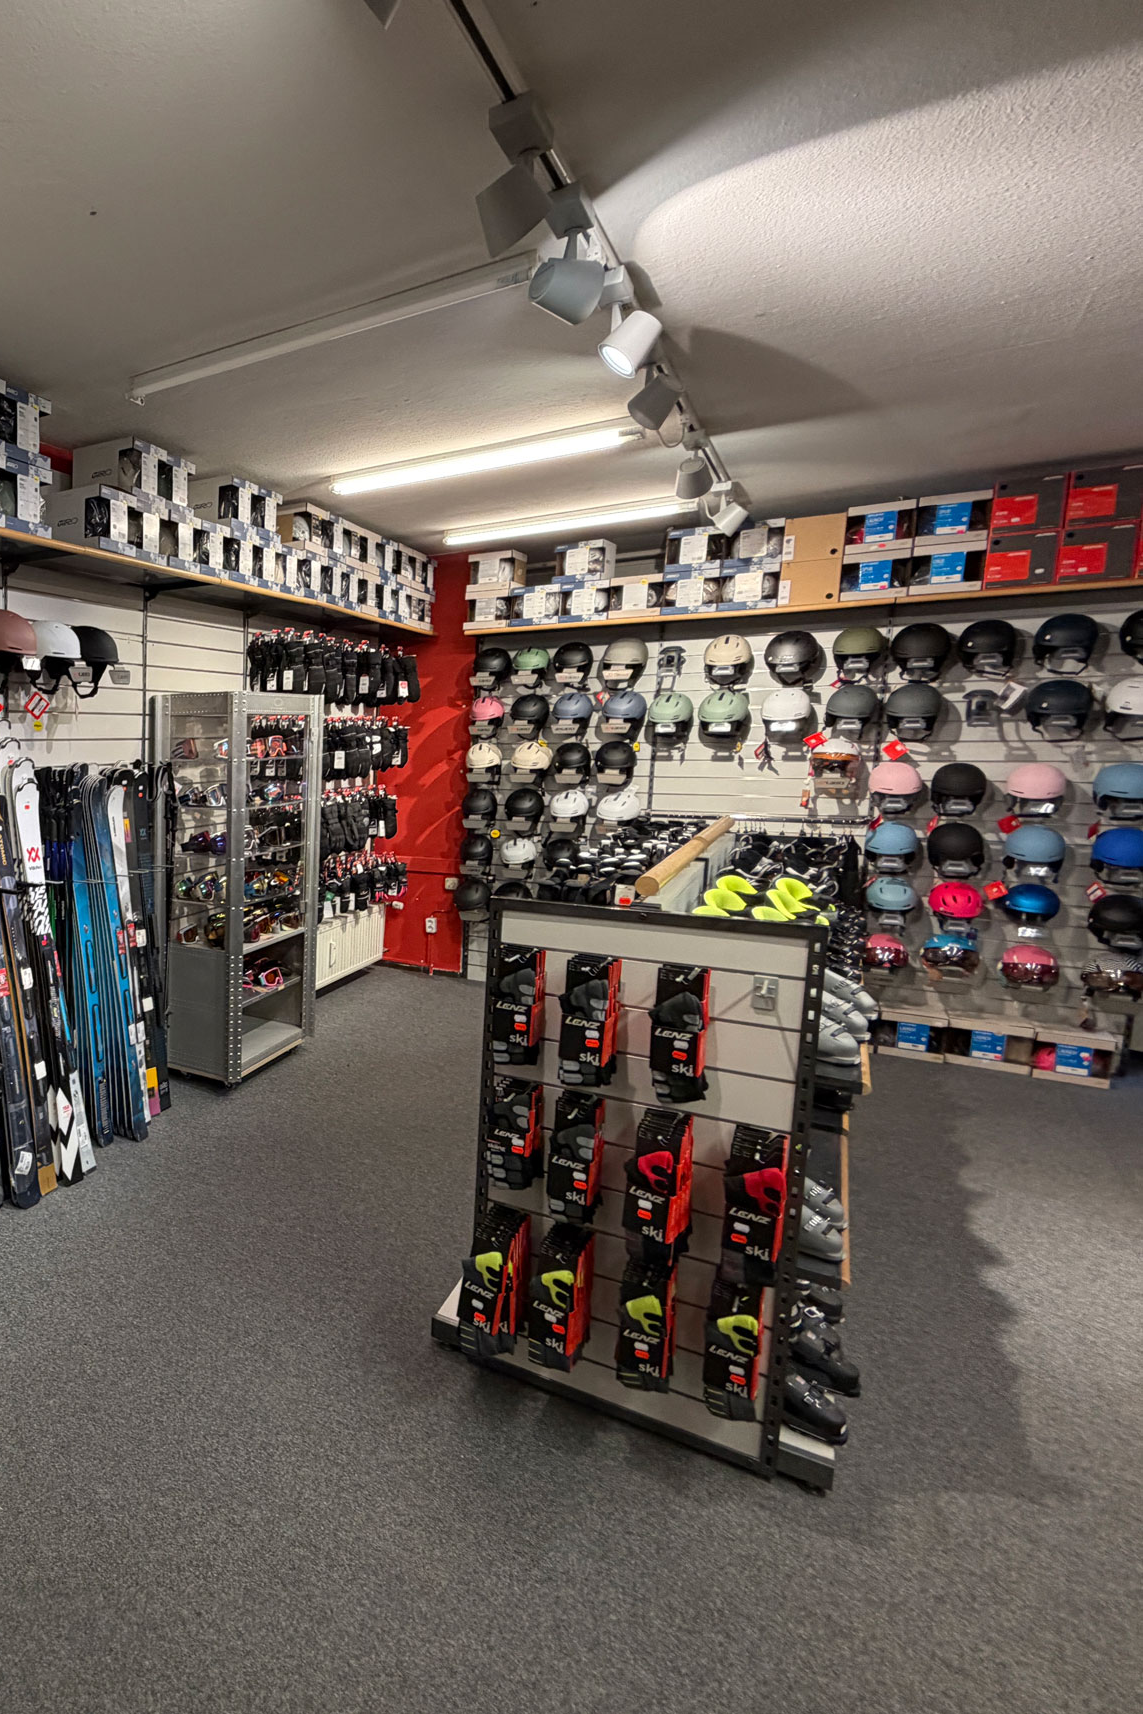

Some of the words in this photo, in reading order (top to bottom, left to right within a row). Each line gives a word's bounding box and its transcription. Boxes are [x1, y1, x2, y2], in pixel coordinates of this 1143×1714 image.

[495, 1000, 528, 1013] LENZ
[565, 1015, 601, 1029] LENZ
[509, 1033, 528, 1047] ski
[654, 1027, 693, 1041] LENZ
[579, 1052, 600, 1067] ski
[671, 1062, 694, 1078] ski
[493, 1128, 520, 1139] LENZ
[551, 1155, 585, 1170] LENZ
[565, 1190, 586, 1206] ski
[628, 1185, 666, 1205] LENZ
[729, 1206, 772, 1225] LENZ
[641, 1225, 664, 1243] ski
[745, 1245, 770, 1262] ski
[464, 1280, 495, 1300] LENZ
[532, 1300, 565, 1319] LENZ
[473, 1317, 491, 1334] ski
[622, 1328, 660, 1345] LENZ
[545, 1337, 564, 1355] ski
[708, 1344, 750, 1364] LENZ
[638, 1363, 660, 1378] ski
[725, 1382, 749, 1399] ski
